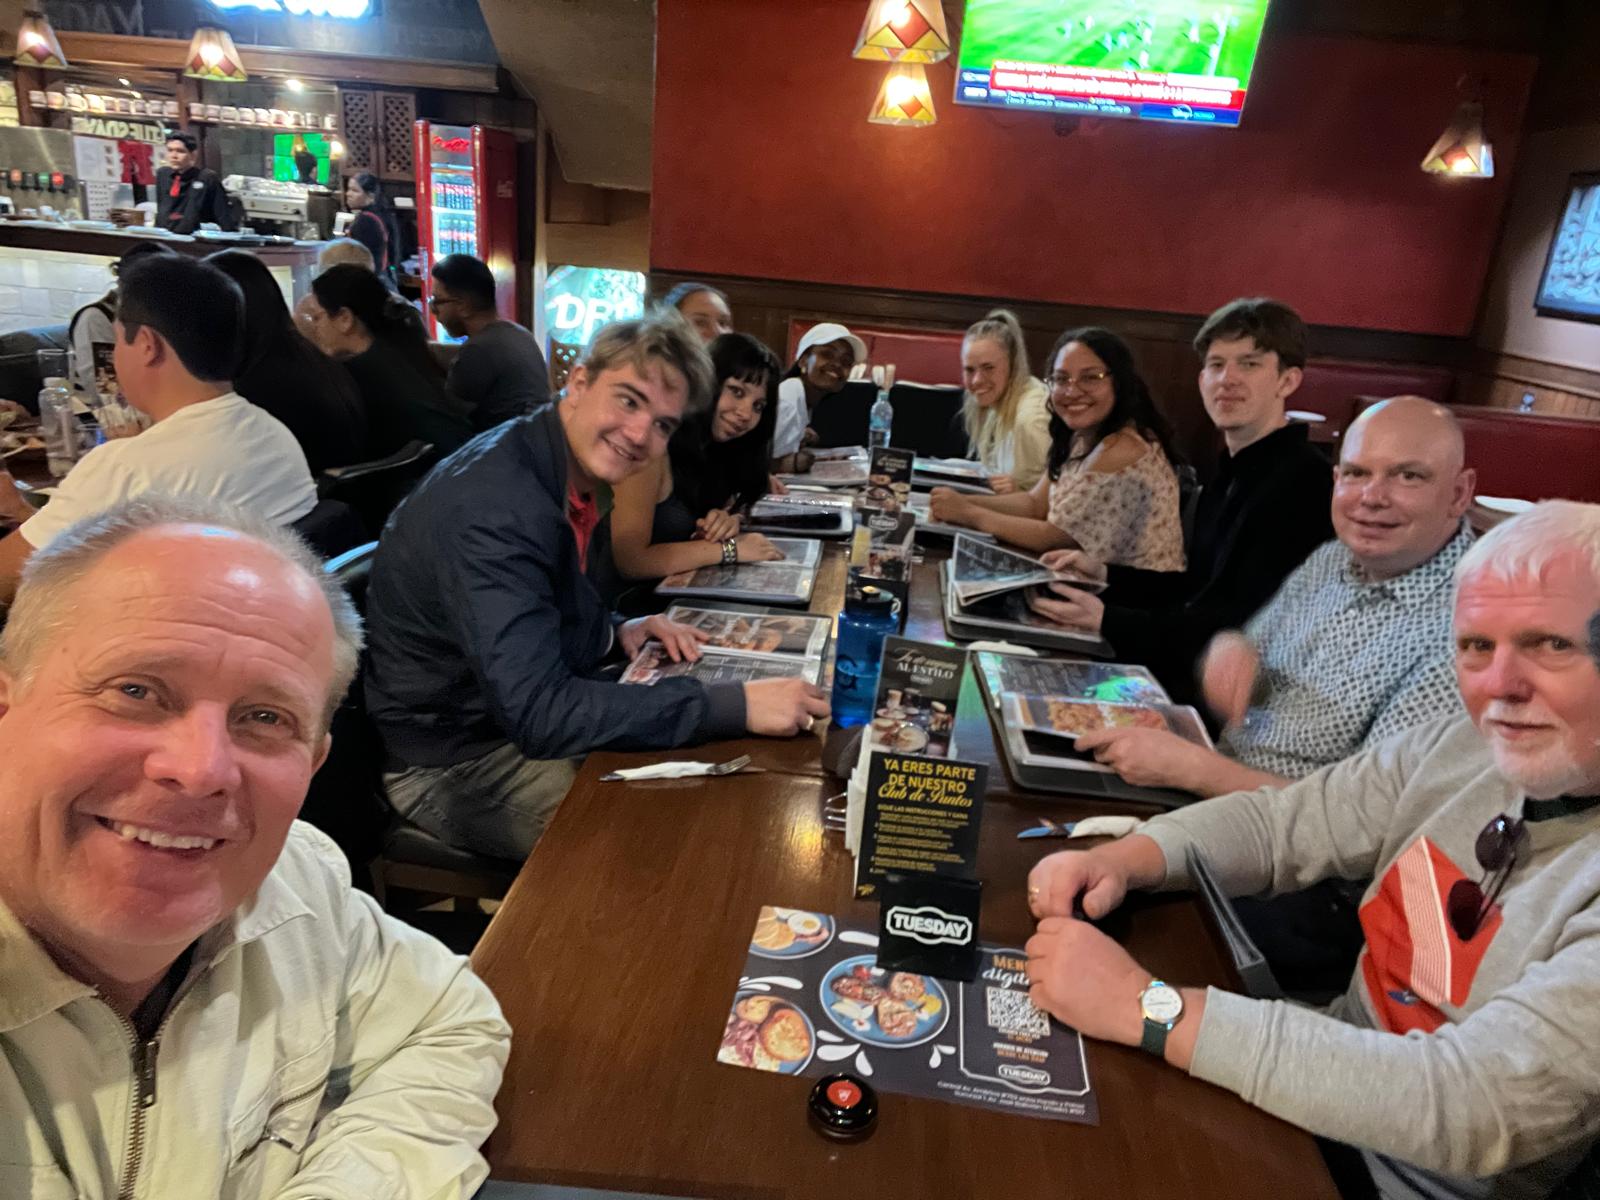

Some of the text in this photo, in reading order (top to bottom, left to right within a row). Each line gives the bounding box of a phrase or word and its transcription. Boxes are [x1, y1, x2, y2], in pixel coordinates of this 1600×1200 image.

[912, 665, 954, 679] ESTILO
[884, 758, 976, 781] YA ERES PARTE
[888, 773, 967, 793] DE NUESTRO
[878, 783, 973, 807] Club de Puntos
[894, 913, 966, 938] TUESDAY
[993, 954, 1027, 971] MEN
[1003, 1068, 1046, 1082] TUESDAY
